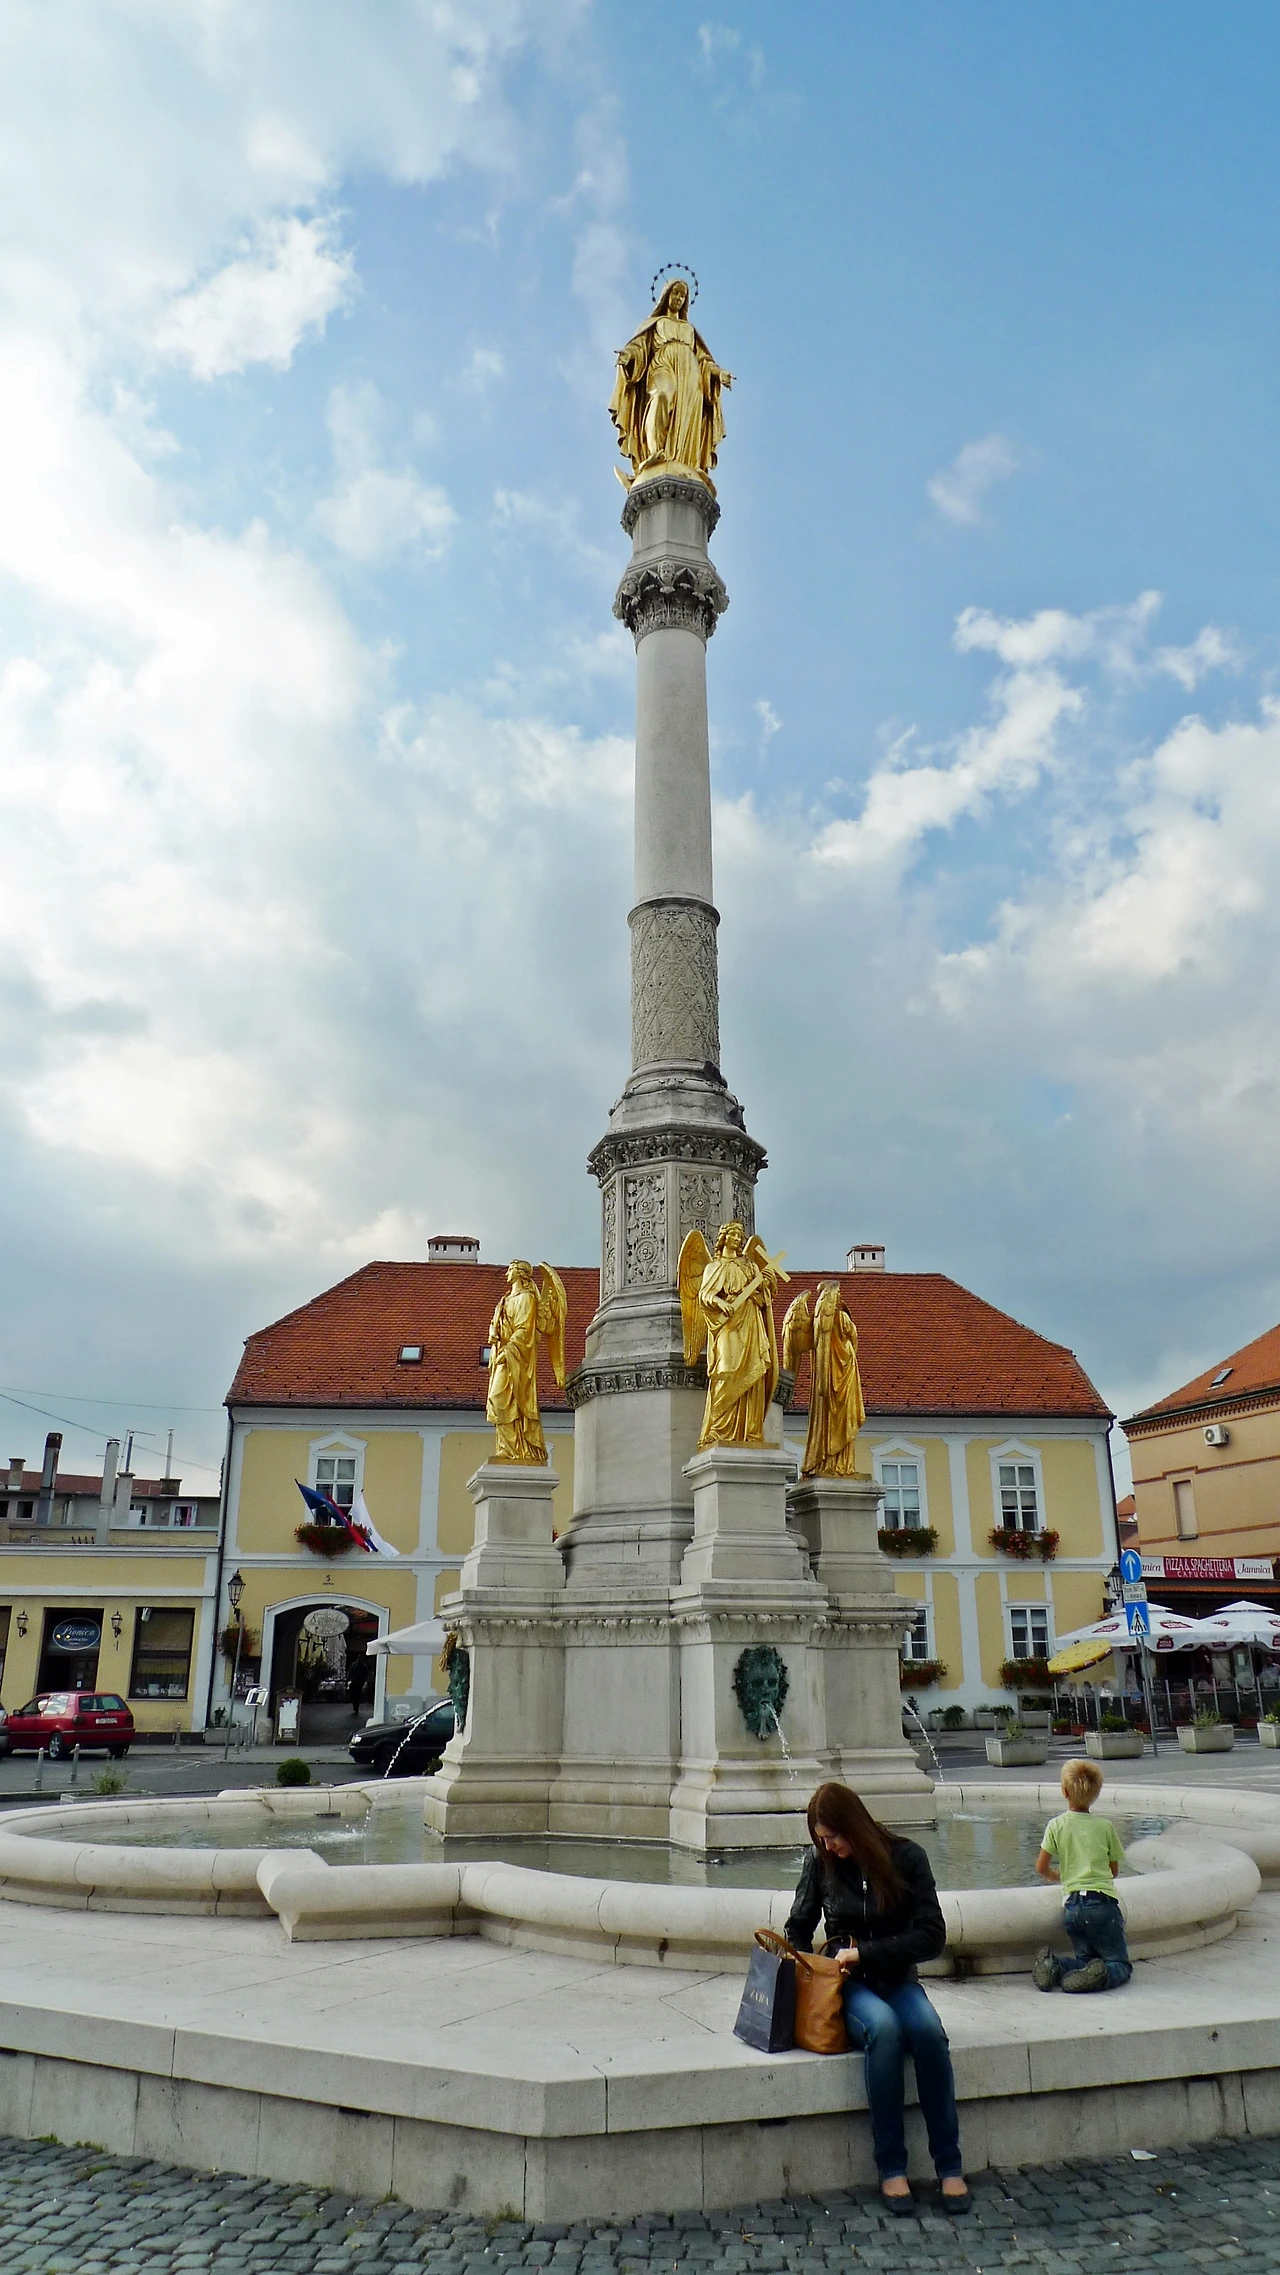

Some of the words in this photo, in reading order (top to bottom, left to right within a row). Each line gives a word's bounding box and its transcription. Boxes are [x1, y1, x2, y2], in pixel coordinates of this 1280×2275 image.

[1142, 1563, 1161, 1572] nica
[1166, 1558, 1184, 1571] PIZZA
[1190, 1558, 1233, 1572] SPAGHETTERIA
[1237, 1563, 1271, 1574] Jamnica
[749, 1989, 769, 2006] ZARA
